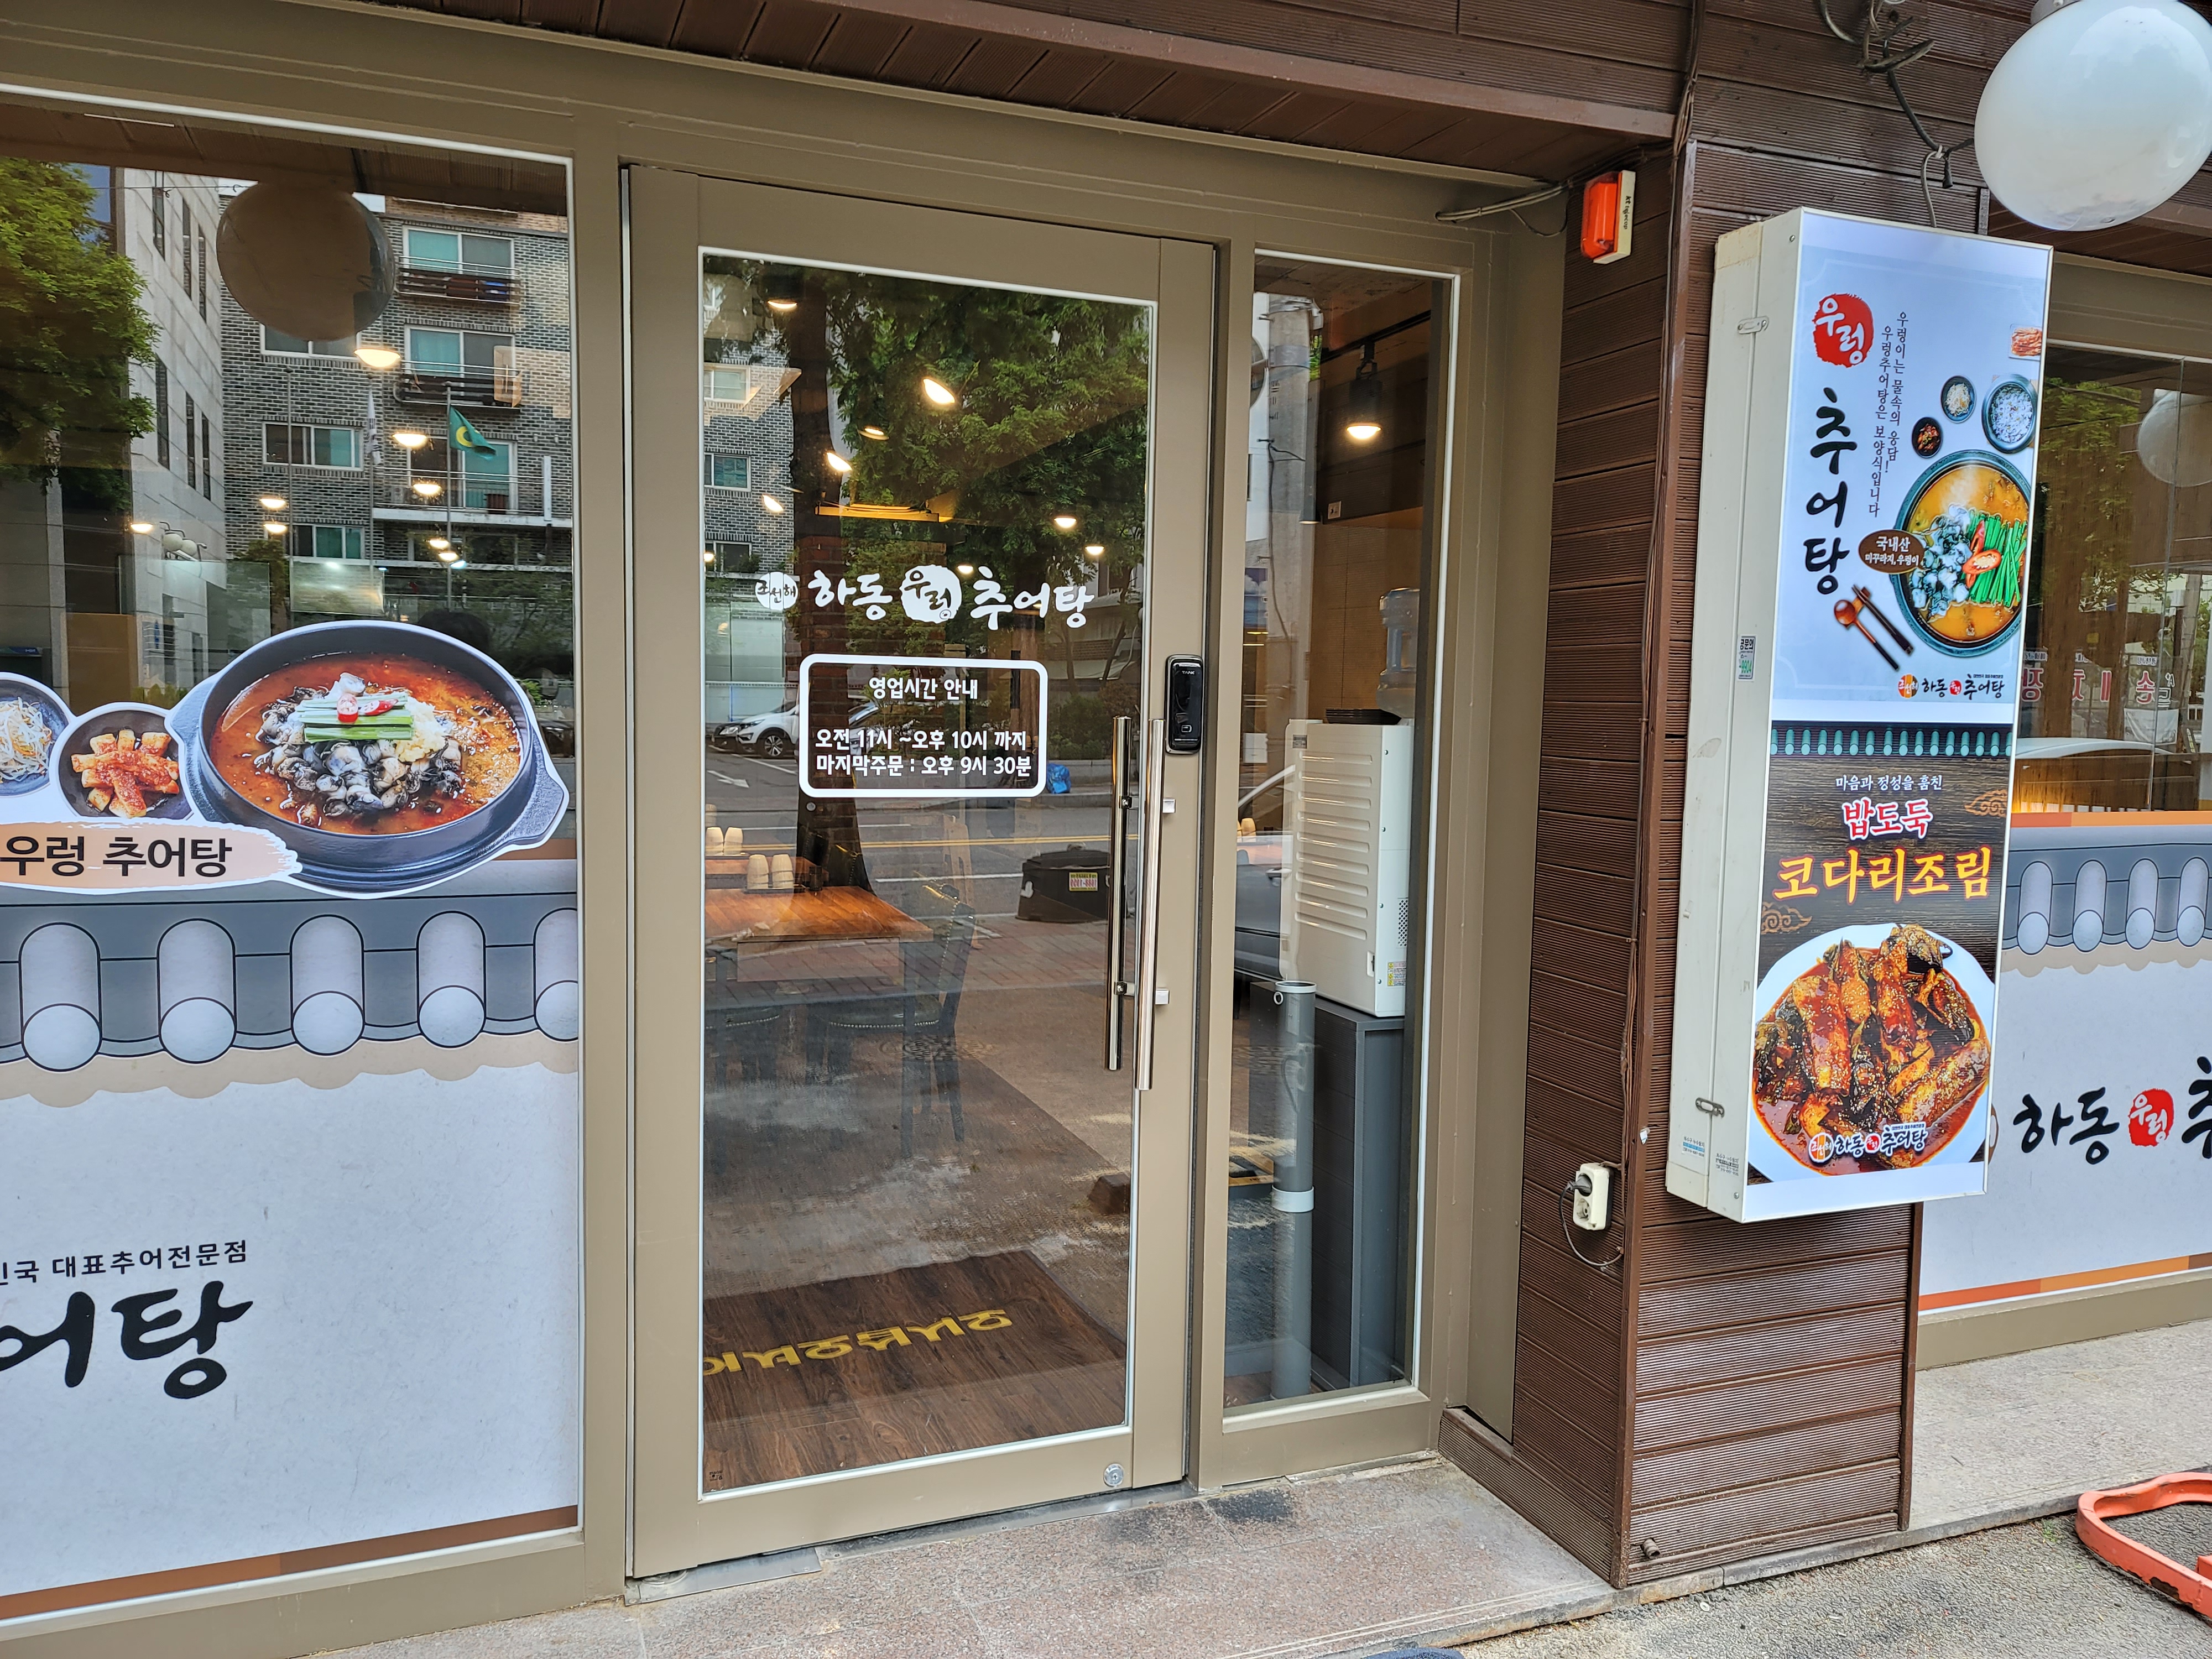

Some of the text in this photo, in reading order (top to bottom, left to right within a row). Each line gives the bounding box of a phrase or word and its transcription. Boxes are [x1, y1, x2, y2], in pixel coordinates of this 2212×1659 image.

[1815, 298, 1866, 366] 우렁
[1893, 311, 1909, 375] 우렁이는
[1868, 326, 1893, 518] 우렁추어탕은 보양식입니다
[1890, 379, 1905, 427] 물속의
[1803, 387, 1858, 596] 추어탕
[1876, 536, 1911, 551] 국내산
[808, 569, 894, 621] 하동
[902, 568, 953, 620] 우렁
[971, 566, 1095, 630] 추어탕
[869, 677, 978, 700] 영업시간 안내
[1922, 678, 1948, 698] 하동
[1964, 674, 2005, 700] 추어탕
[816, 730, 850, 750] 오전
[857, 729, 893, 750] 11시
[952, 729, 988, 750] 10시
[994, 730, 1026, 751] 까지
[816, 755, 904, 777] 마지막주문
[921, 755, 954, 775] 오후
[961, 755, 987, 776] 9시
[993, 756, 1031, 777] 30분
[1836, 775, 1942, 791] 마음과 정성을 훔친
[1843, 797, 1934, 839] 밥도둑
[0, 836, 232, 878] 우렁 추어탕
[1773, 847, 1991, 904] 코다리조림
[1836, 1134, 1864, 1155] 하동
[1866, 1136, 1879, 1150] 우렁
[1881, 1126, 1927, 1155] 추어탕
[2013, 1086, 2120, 1165] 하동
[2129, 1093, 2169, 1144] 우렁
[53, 1240, 246, 1278] 대표추어전문점
